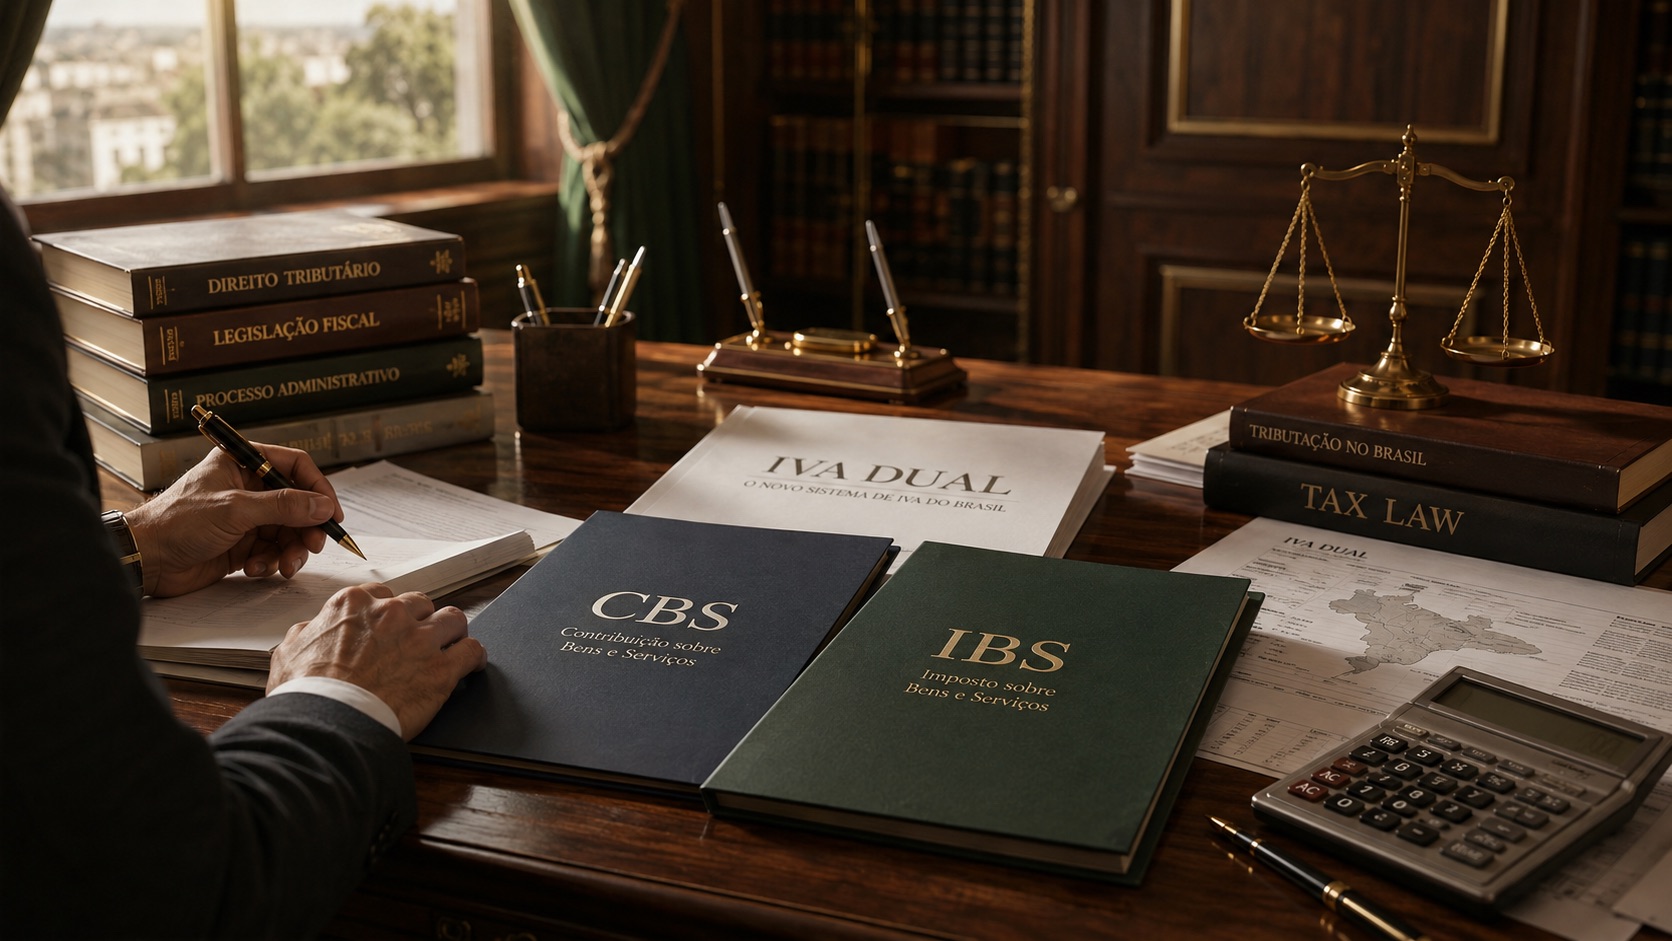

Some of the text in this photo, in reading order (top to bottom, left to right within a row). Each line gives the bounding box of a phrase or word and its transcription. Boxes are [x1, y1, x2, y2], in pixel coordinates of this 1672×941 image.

[208, 261, 381, 294] DIREITO TRIBUTÁRIO
[213, 312, 380, 346] LEGISLAÇÃO FISCAL
[196, 385, 274, 408] PROCESSO
[277, 367, 400, 397] ADMINISTRATIVO
[1249, 424, 1342, 451] TRIBUTAÇÃO
[1346, 441, 1369, 456] NO
[1373, 445, 1427, 466] BRASIL
[761, 456, 1011, 495] IVA DUAL
[759, 481, 803, 492] NOVO
[805, 487, 867, 499] SISTEMA
[872, 492, 894, 502] DE
[897, 495, 921, 504] IVA
[926, 498, 950, 506] DO
[953, 501, 1006, 512] BRASIL
[1301, 483, 1464, 535] TAX LAW
[1283, 536, 1314, 549] IVA
[1319, 543, 1368, 559] DUAL
[591, 591, 739, 631] CBS
[560, 626, 721, 654] Contribuição sobre
[560, 641, 697, 666] Bens e Serviços
[930, 628, 1071, 673] IBS
[905, 682, 1050, 712] Bens e Serviços
[920, 669, 1056, 697] Imposto sobre
[1295, 782, 1320, 795] AC
[1319, 770, 1341, 782] AC
